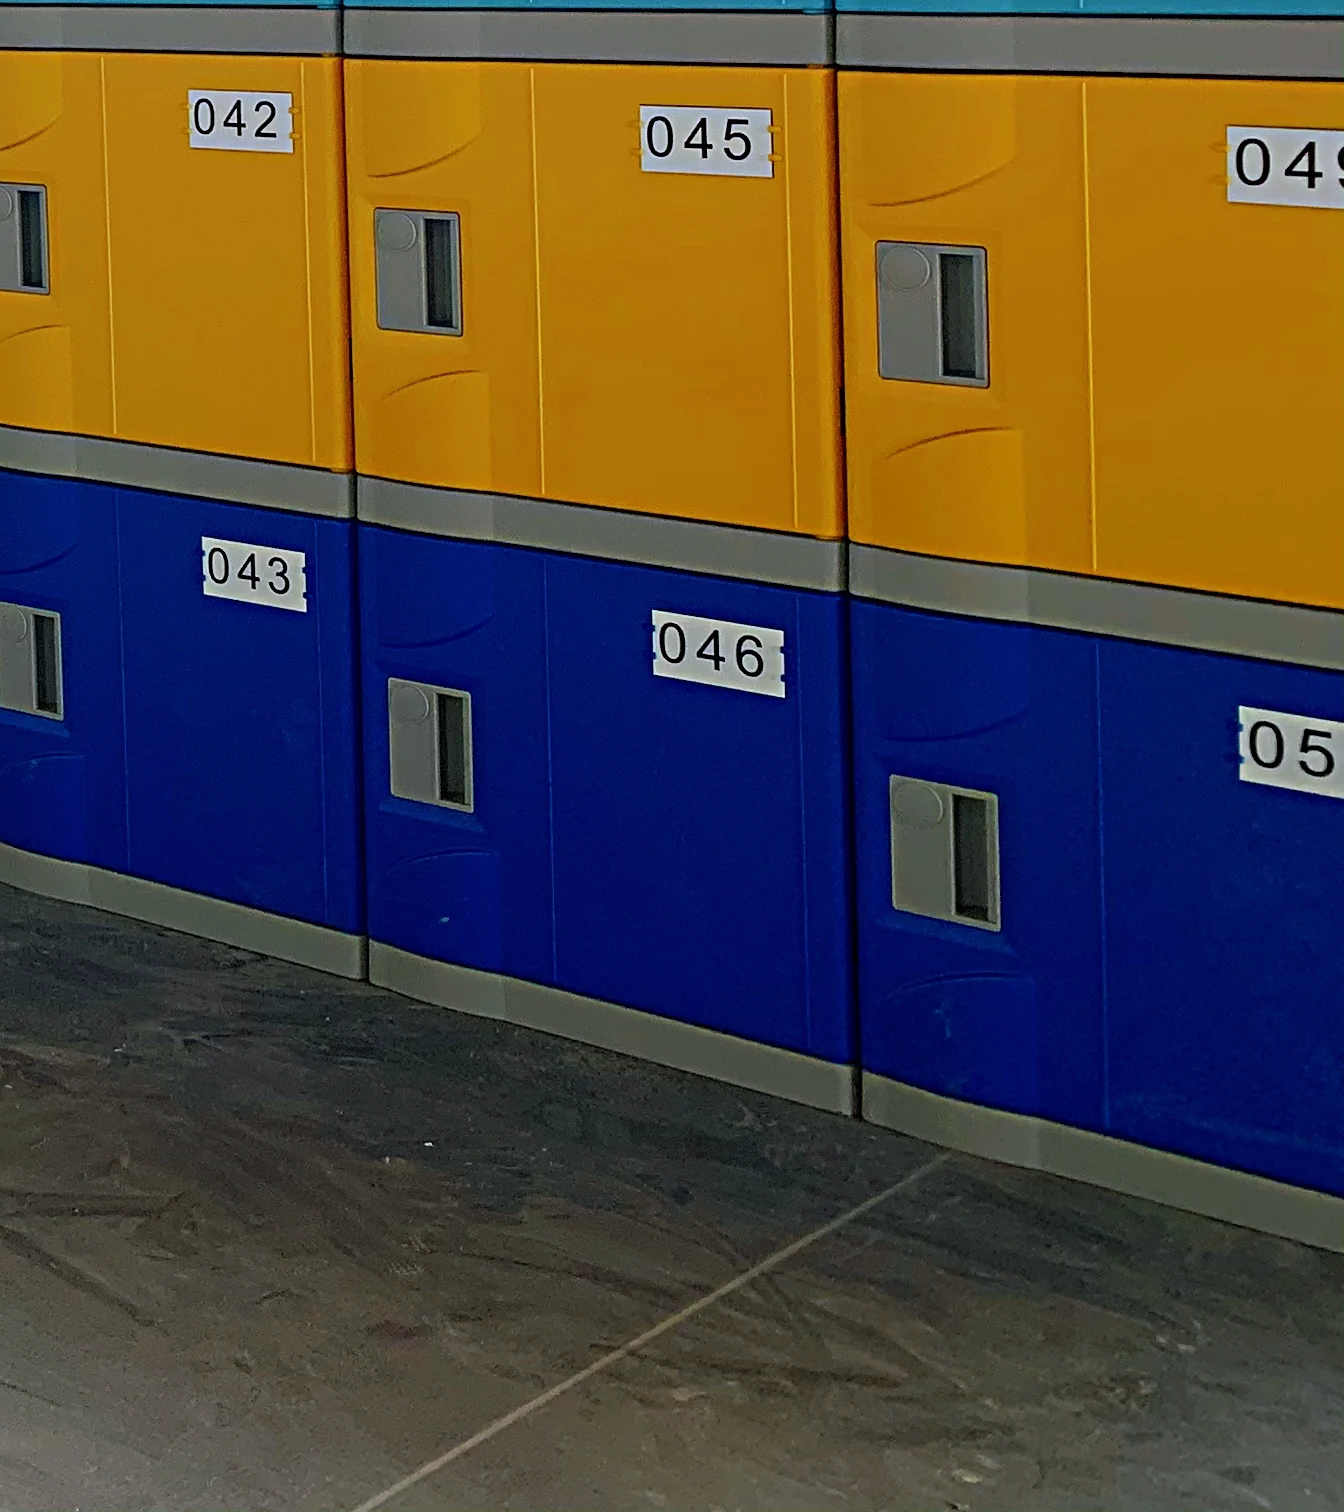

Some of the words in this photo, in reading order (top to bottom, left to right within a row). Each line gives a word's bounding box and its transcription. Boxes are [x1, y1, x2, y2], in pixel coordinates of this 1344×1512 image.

[194, 99, 276, 138] 042
[647, 116, 751, 160] 045
[1236, 139, 1344, 188] 04
[208, 548, 289, 594] 043
[660, 623, 763, 677] 046
[1249, 720, 1335, 778] 05
